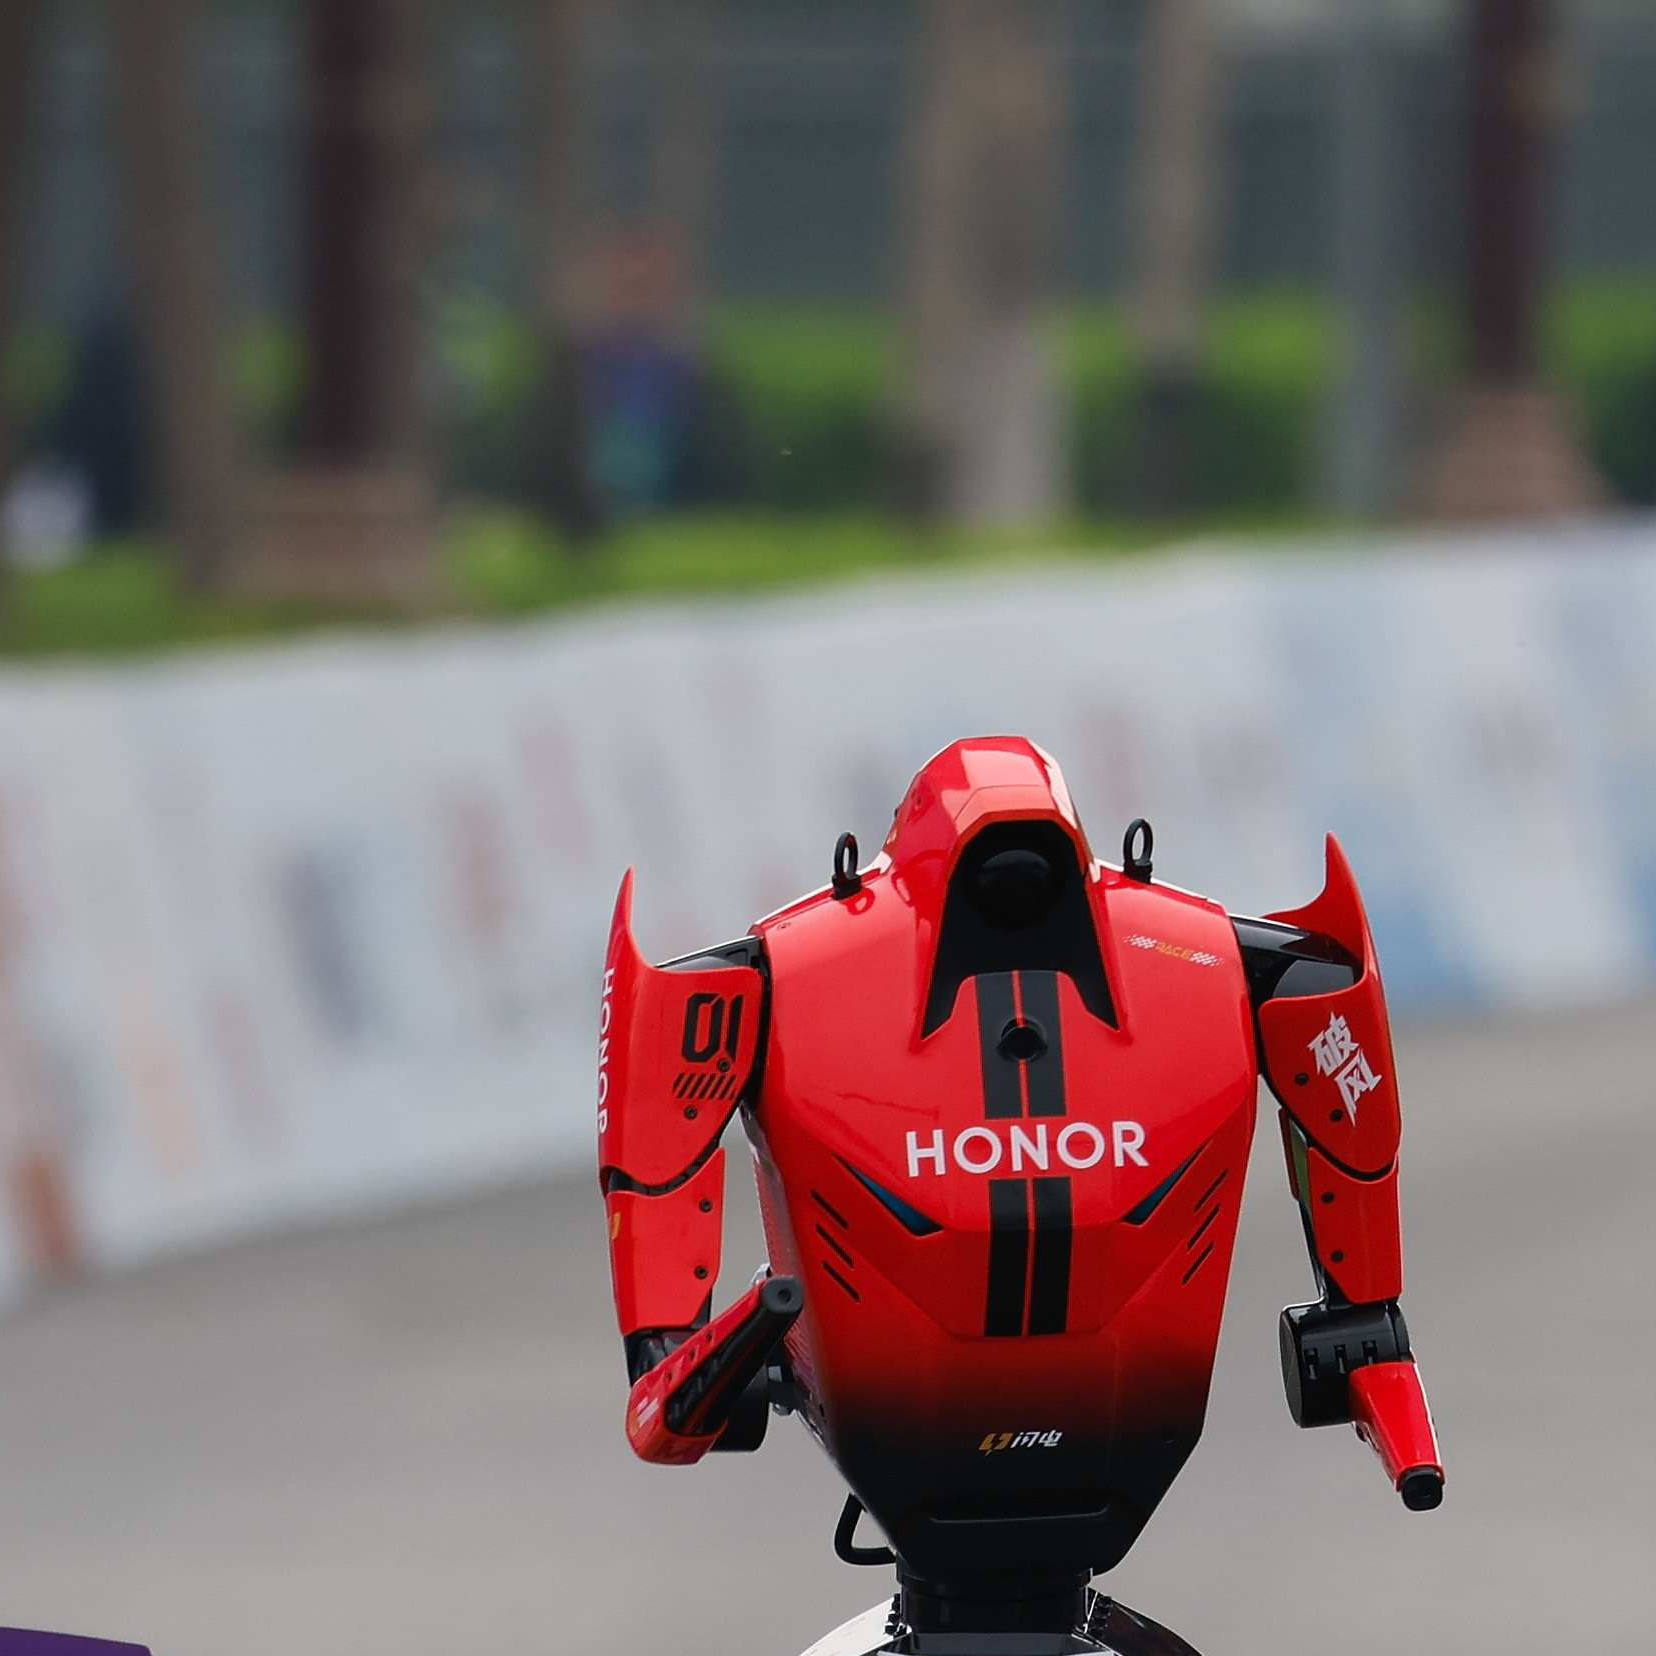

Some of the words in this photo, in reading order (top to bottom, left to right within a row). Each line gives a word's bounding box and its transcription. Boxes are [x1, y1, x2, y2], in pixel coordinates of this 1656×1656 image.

[598, 967, 615, 1134] HONOR
[682, 992, 744, 1063] 01
[1306, 1011, 1383, 1127] 破风
[906, 1120, 1149, 1177] HONOR
